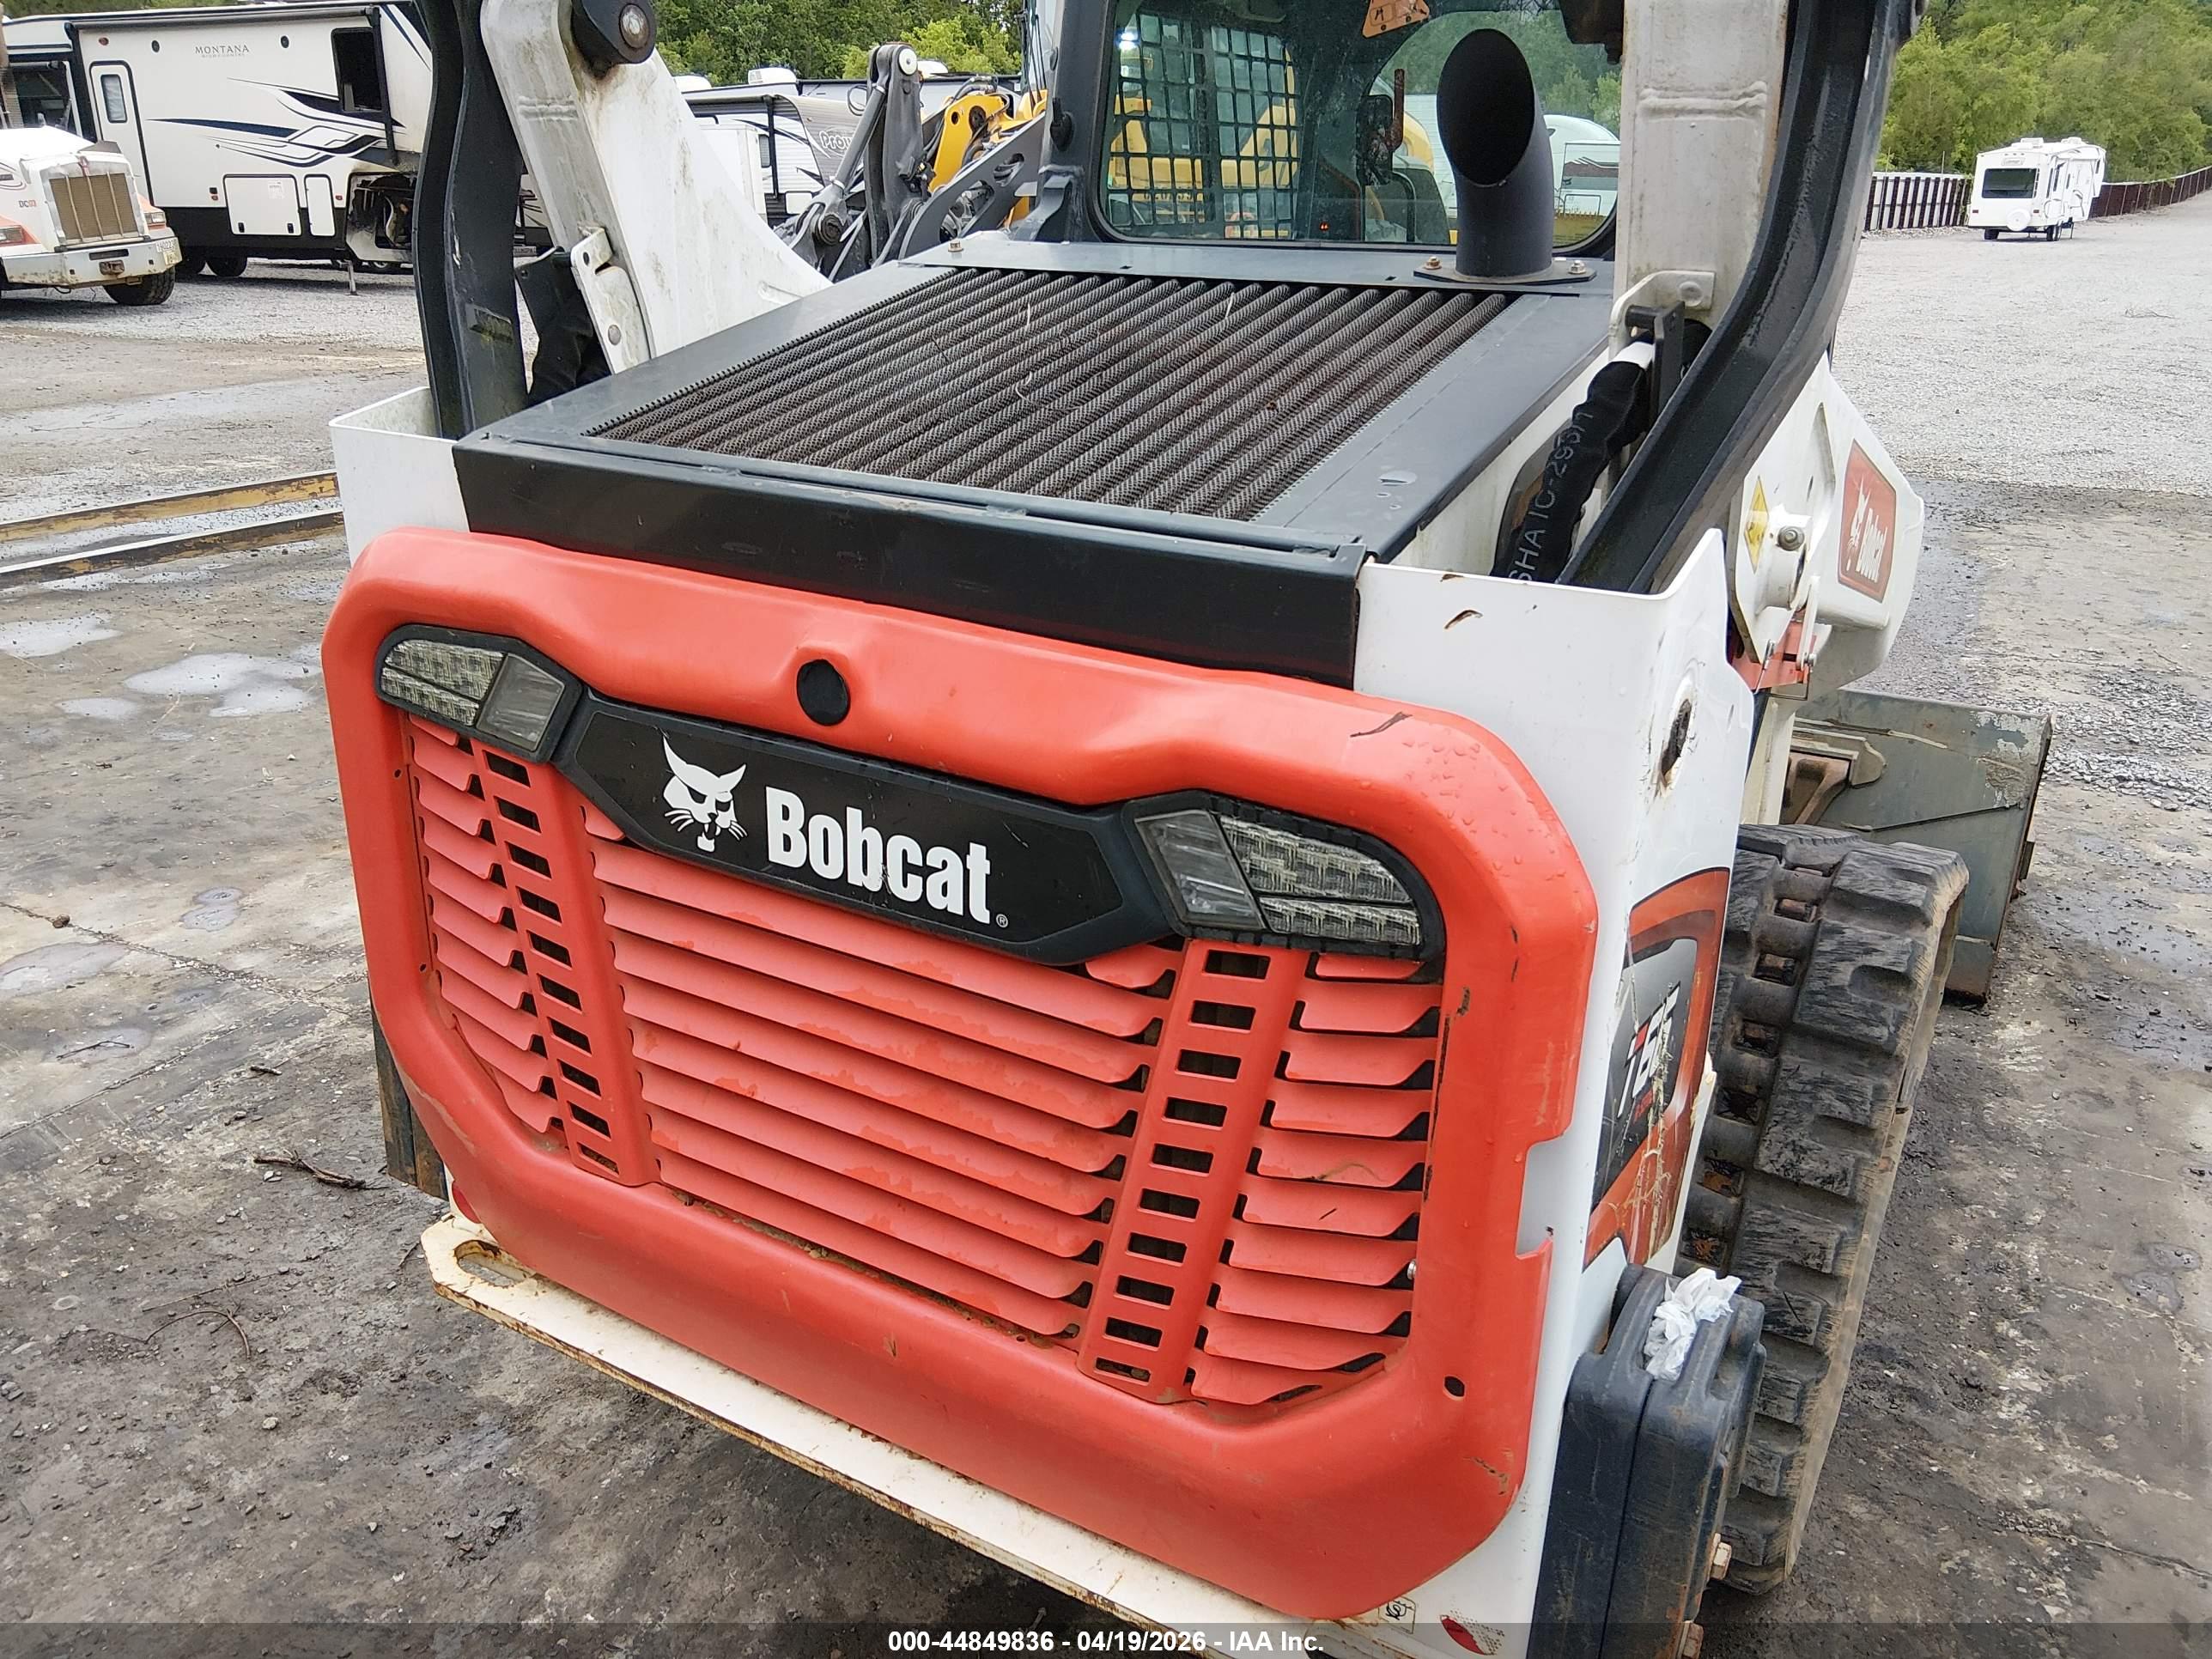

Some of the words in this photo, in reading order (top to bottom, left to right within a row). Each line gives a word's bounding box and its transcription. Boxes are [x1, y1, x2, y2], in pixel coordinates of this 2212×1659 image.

[195, 44, 249, 54] MONTANA
[1856, 507, 1888, 583] Bobcat
[765, 786, 991, 924] Bobcat
